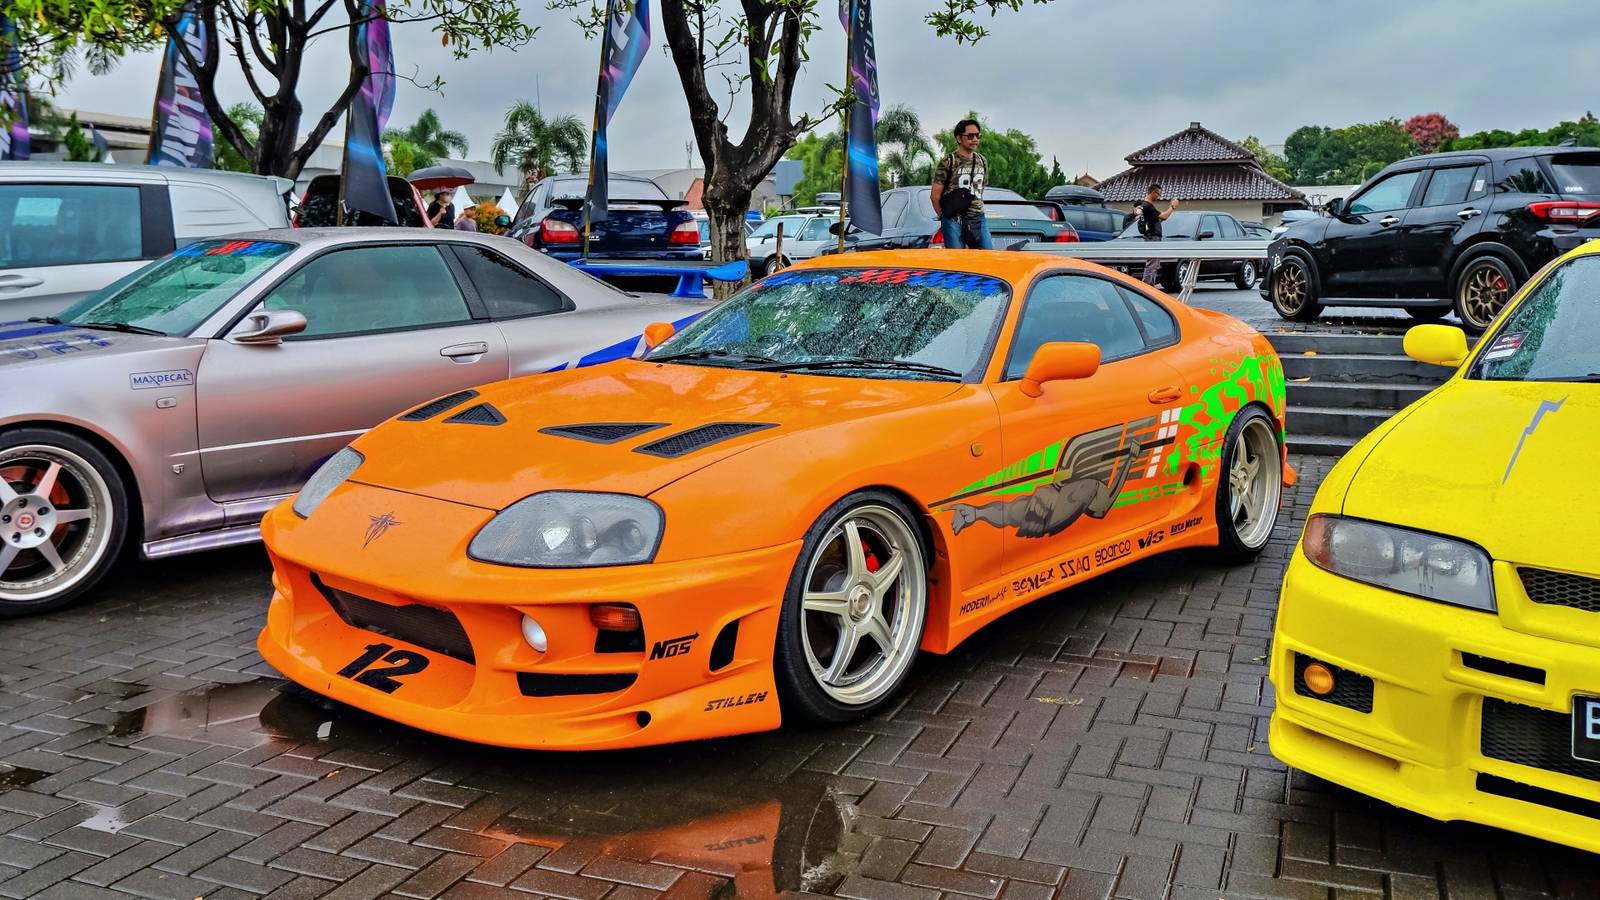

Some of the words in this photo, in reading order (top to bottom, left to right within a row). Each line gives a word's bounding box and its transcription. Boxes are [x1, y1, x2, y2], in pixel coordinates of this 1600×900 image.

[133, 373, 189, 386] MAXDECAL
[1095, 540, 1131, 567] sparco
[649, 637, 695, 660] NOS
[336, 643, 430, 694] 12
[704, 691, 768, 712] STILLEN
